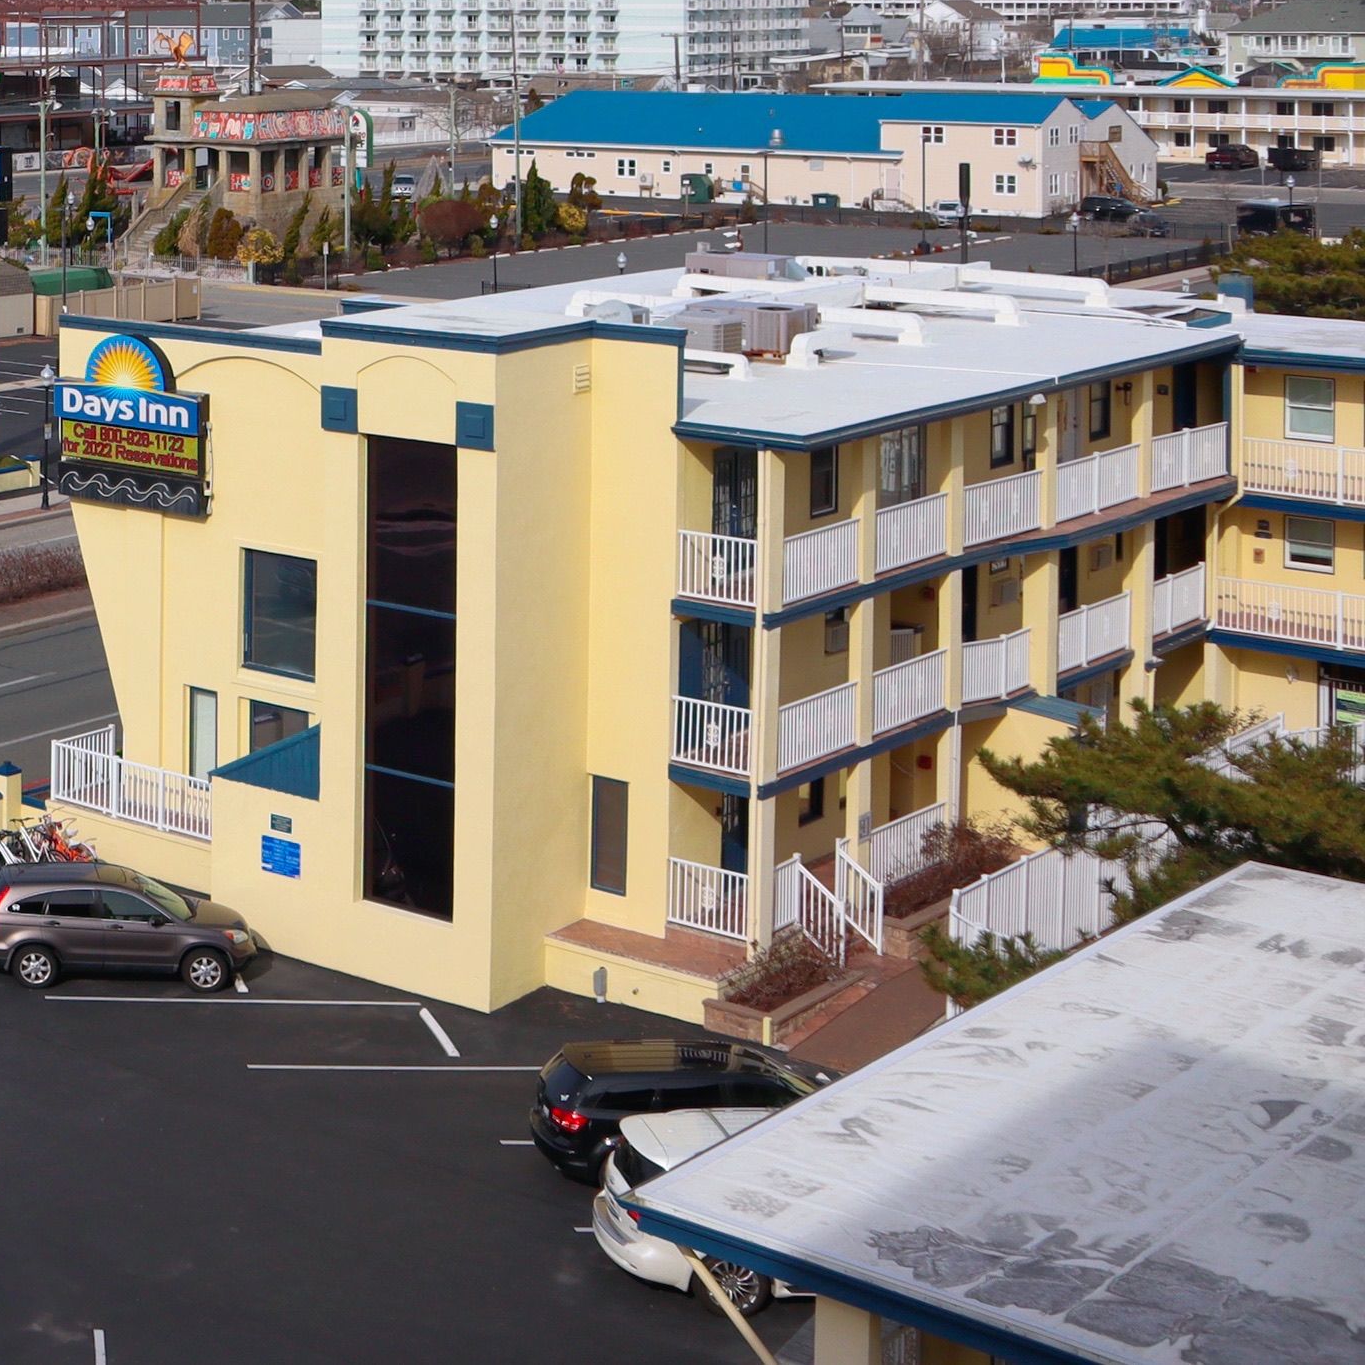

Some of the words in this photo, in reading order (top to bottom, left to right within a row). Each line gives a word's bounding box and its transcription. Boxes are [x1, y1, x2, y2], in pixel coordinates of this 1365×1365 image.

[62, 387, 135, 422] Days
[138, 397, 189, 428] Inn
[73, 423, 97, 440] Call
[63, 437, 79, 453] for
[83, 440, 112, 458] 2022
[115, 445, 198, 471] Reservations
